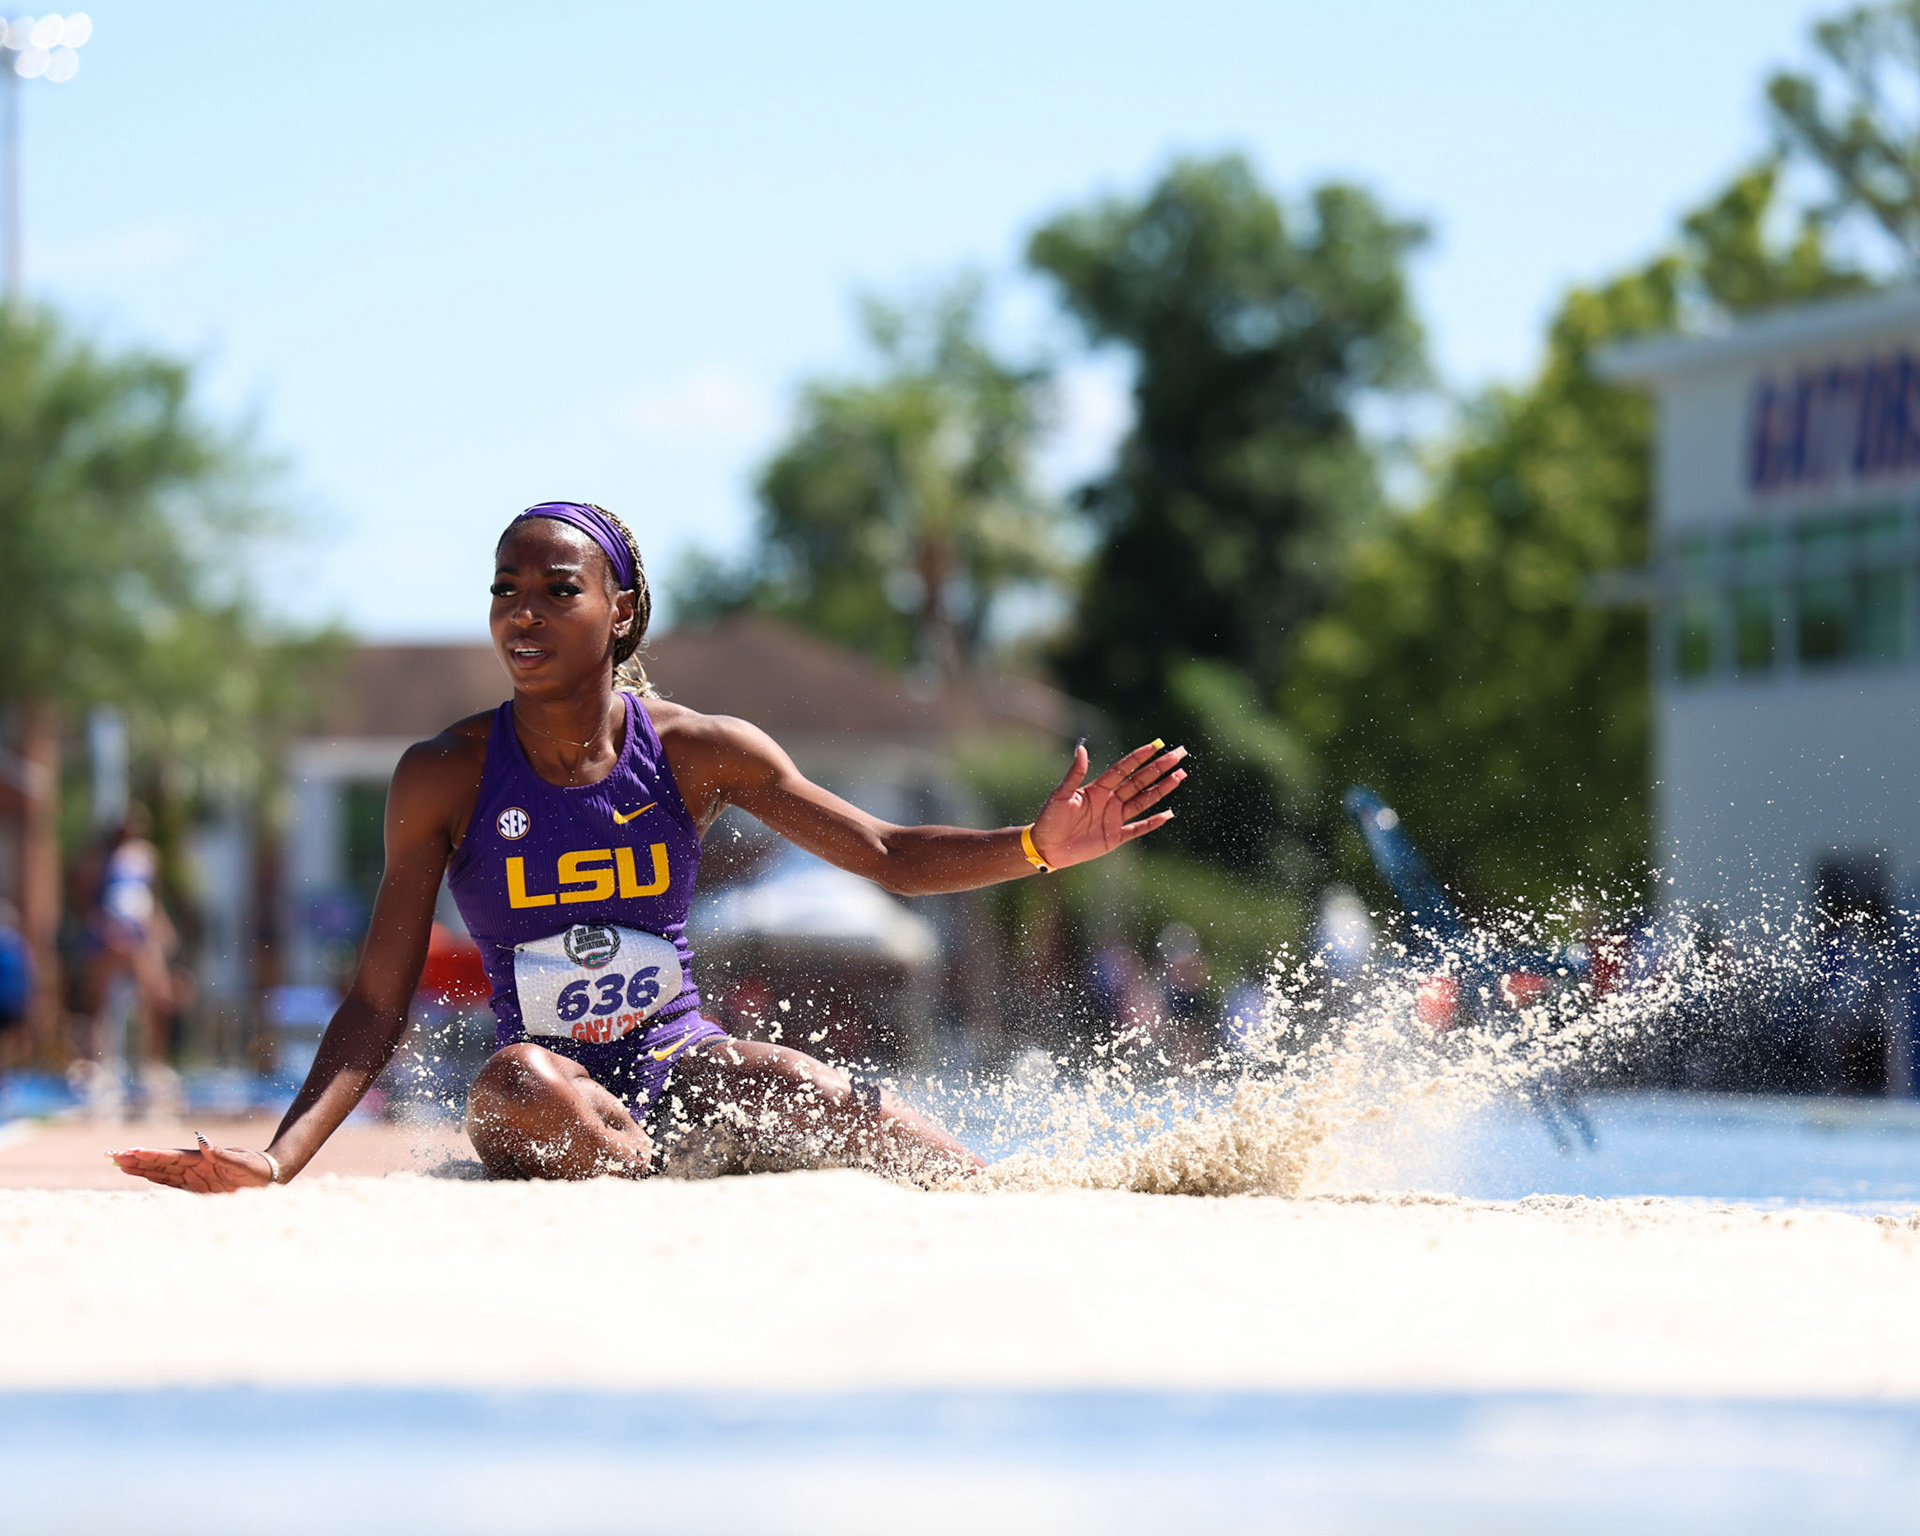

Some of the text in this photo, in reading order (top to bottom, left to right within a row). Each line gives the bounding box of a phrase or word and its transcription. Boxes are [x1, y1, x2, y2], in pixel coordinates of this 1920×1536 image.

[500, 808, 528, 838] SEC
[505, 842, 671, 909] LSU
[556, 966, 661, 1022] 636
[571, 1016, 613, 1044] GNV
